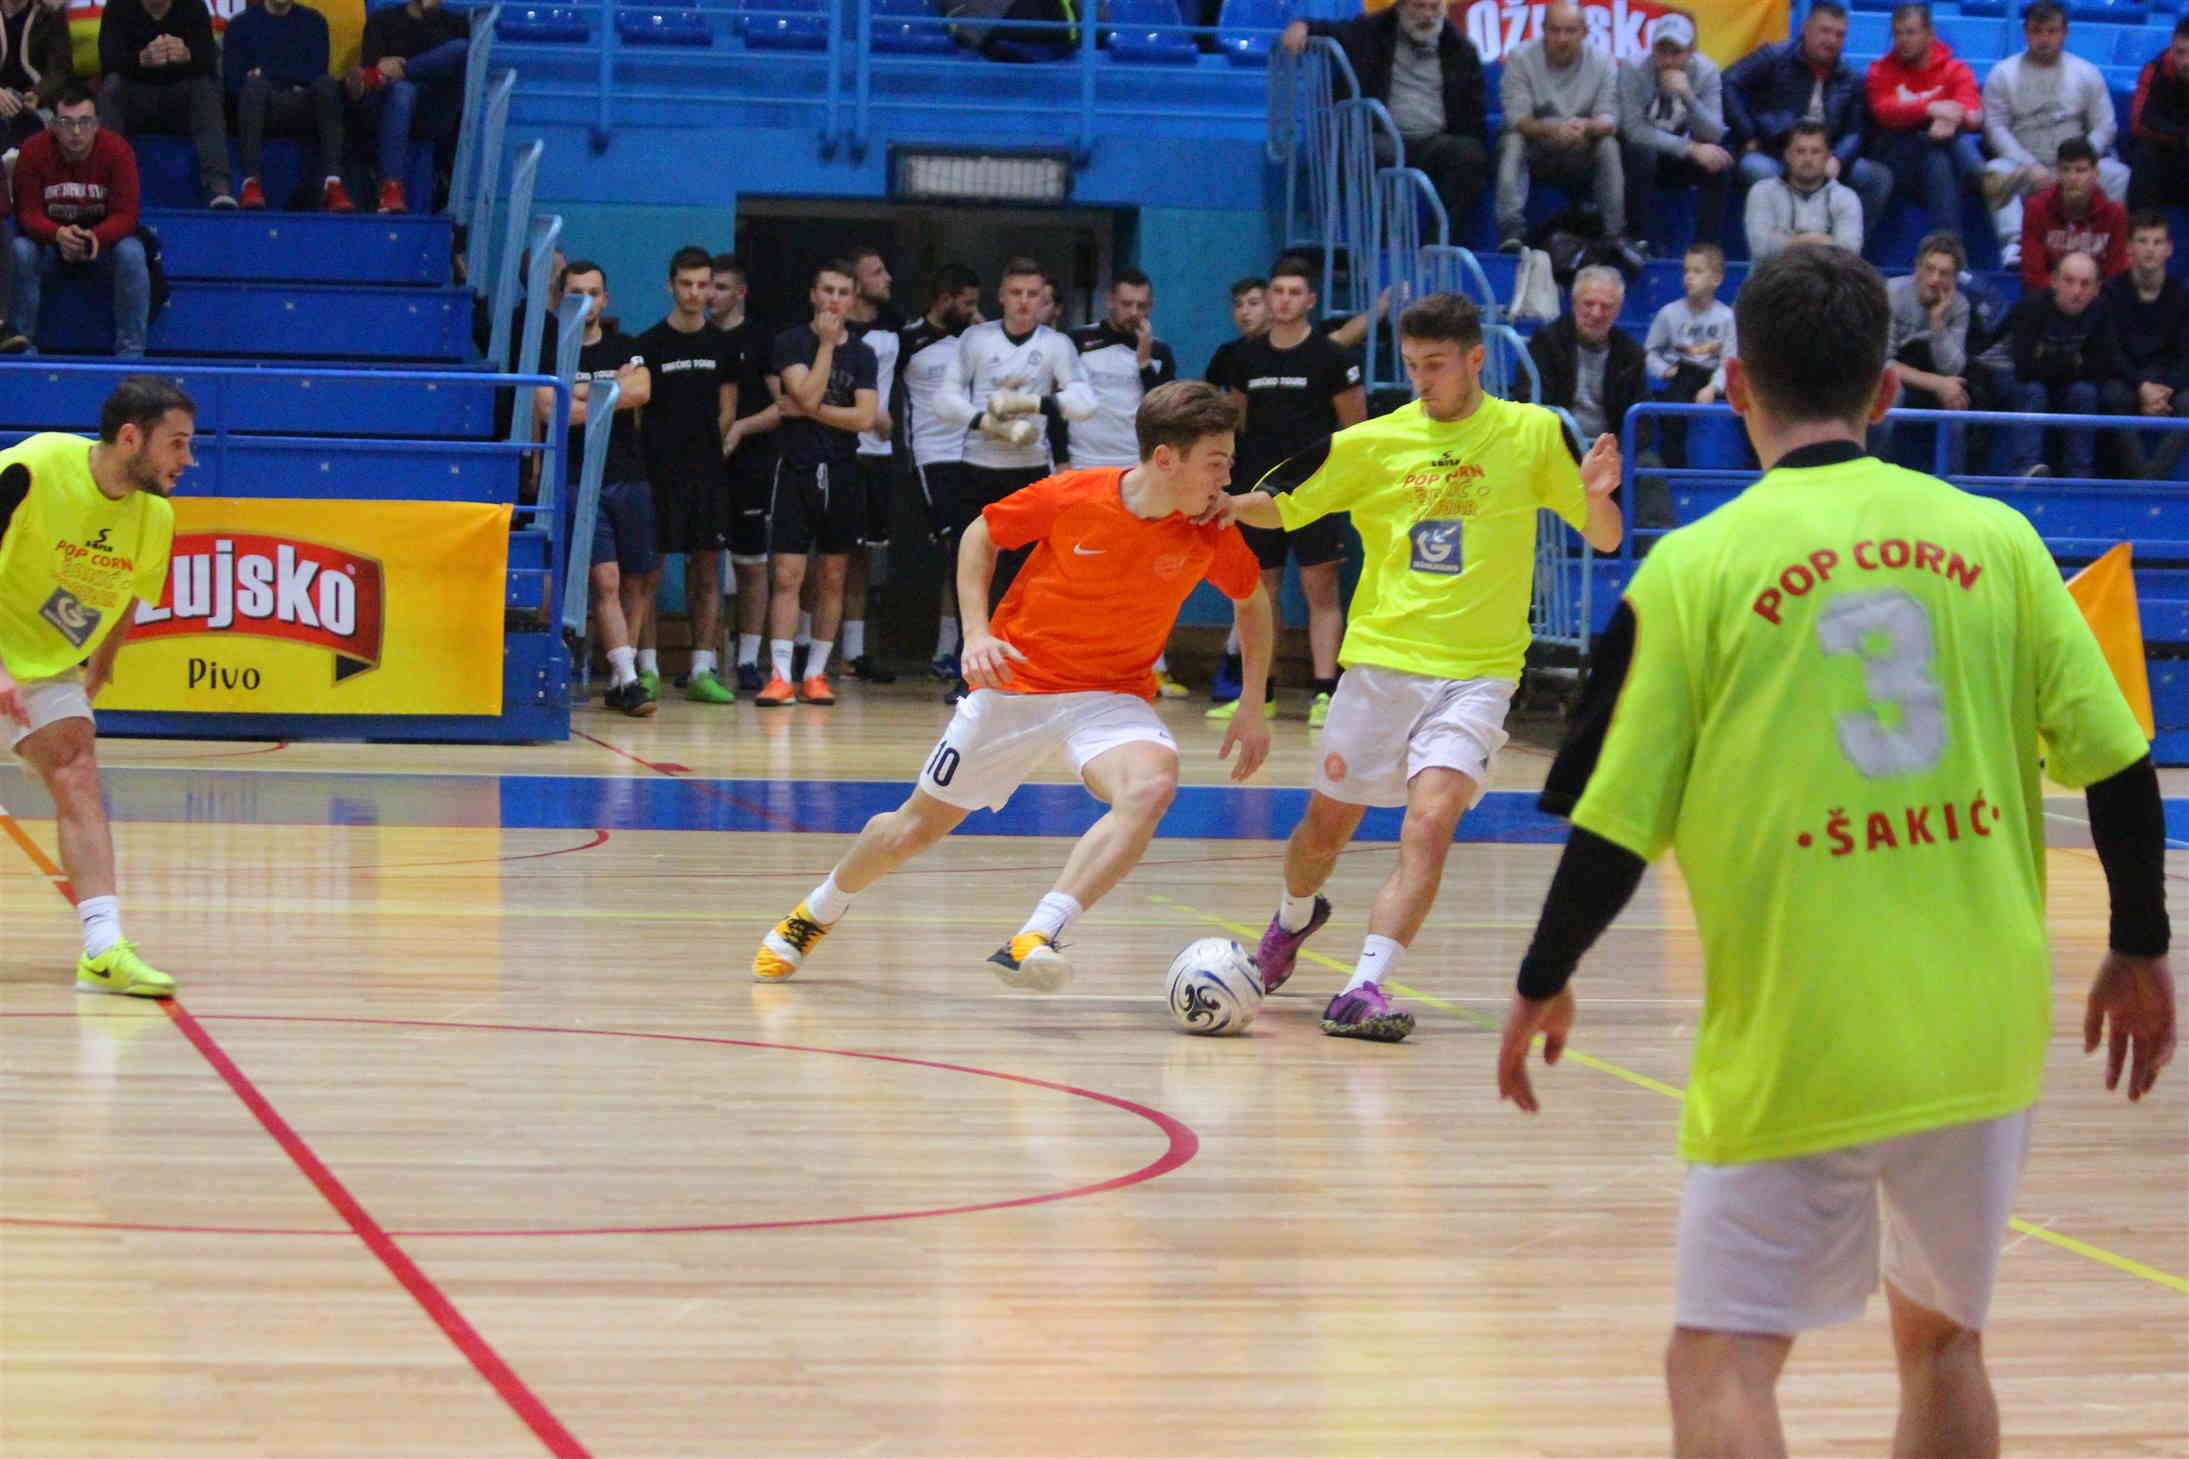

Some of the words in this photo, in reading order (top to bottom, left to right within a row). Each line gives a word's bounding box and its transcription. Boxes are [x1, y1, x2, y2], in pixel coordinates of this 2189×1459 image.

[54, 538, 89, 559] POP
[91, 553, 134, 573] CORN
[1753, 548, 1840, 627] POP
[1853, 538, 1983, 592] CORN
[187, 657, 262, 691] Pivo
[1817, 586, 1947, 779] 3
[926, 740, 961, 787] 10
